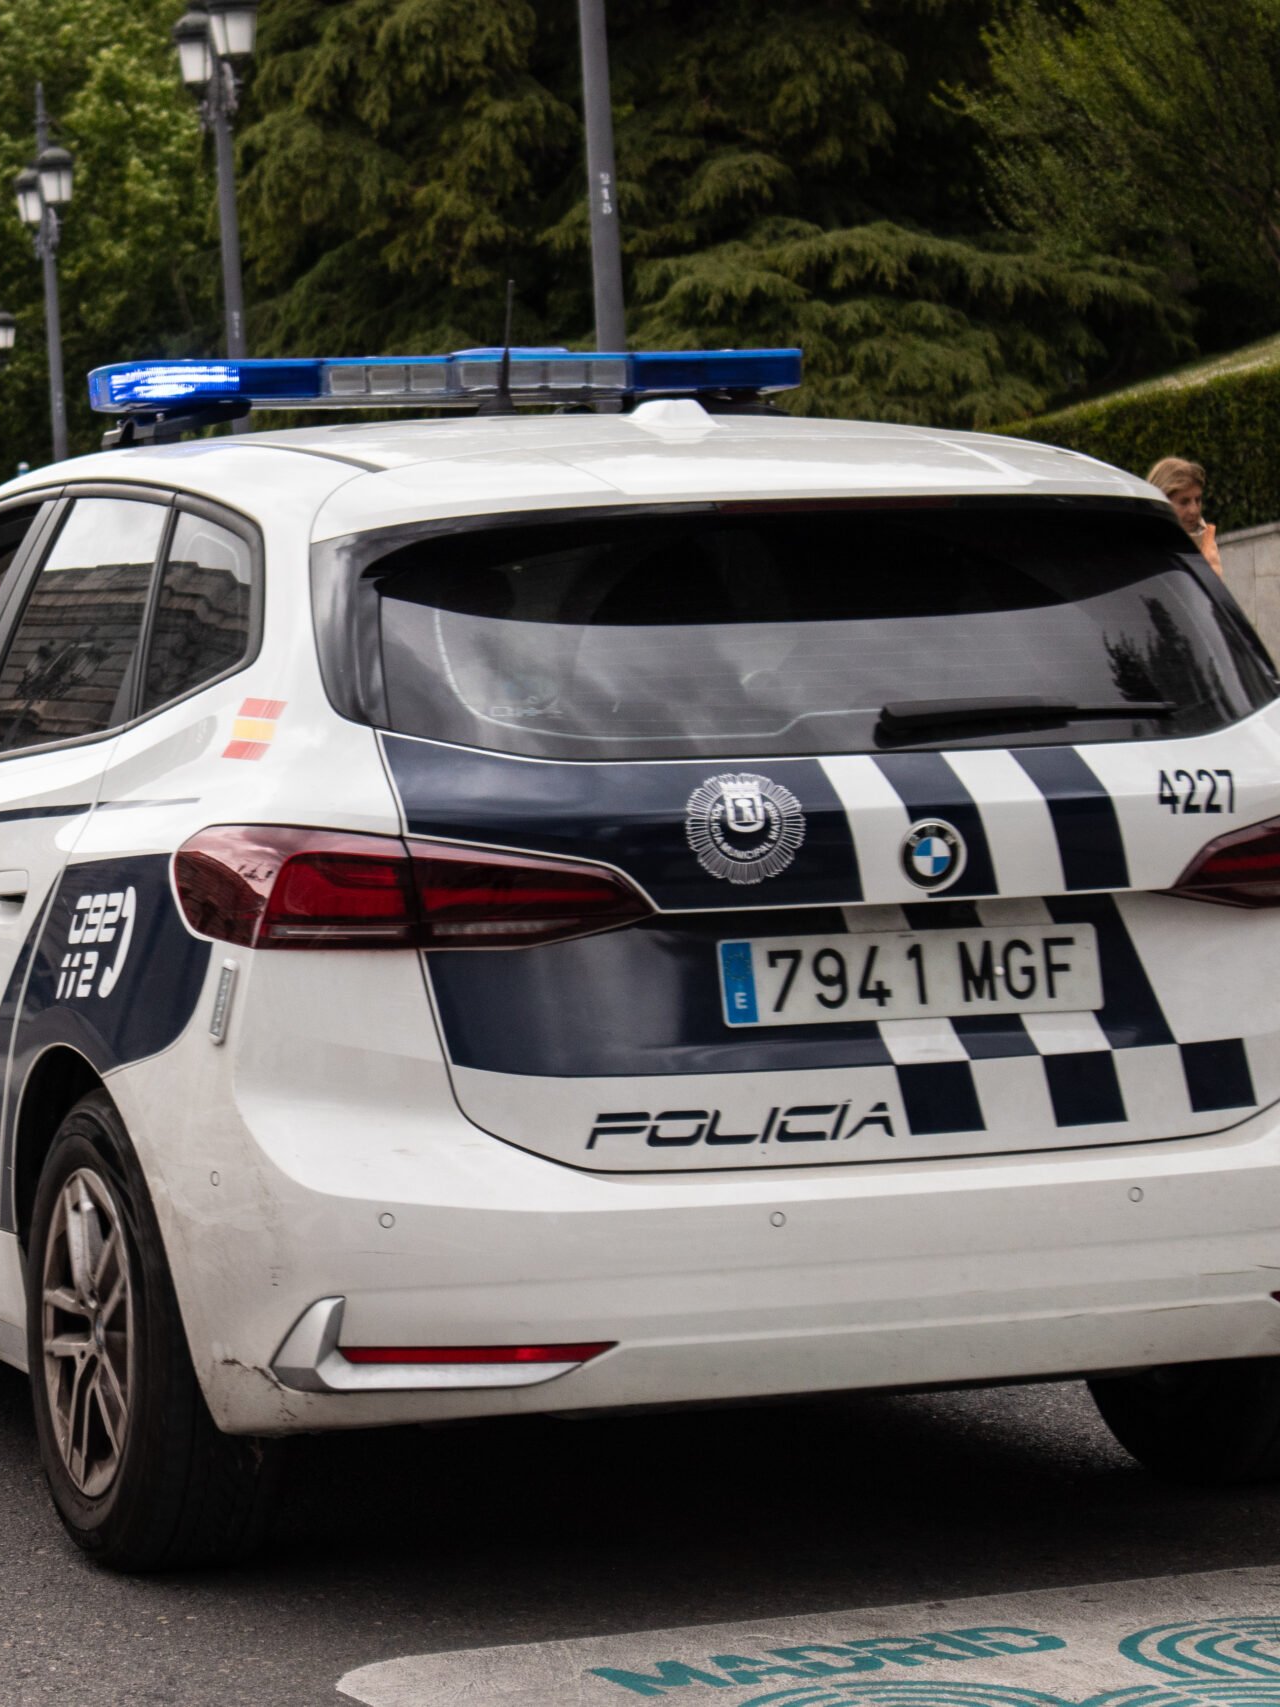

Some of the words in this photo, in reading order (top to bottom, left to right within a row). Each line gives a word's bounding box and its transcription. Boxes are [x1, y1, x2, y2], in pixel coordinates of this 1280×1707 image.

[1158, 769, 1234, 814] 4227
[68, 892, 125, 944] 092
[56, 951, 99, 999] 112
[735, 992, 748, 1009] E
[767, 943, 928, 1013] 7941
[957, 937, 1075, 1003] MGF
[585, 1099, 896, 1150] POLICÍA
[585, 1626, 1067, 1697] MADRID
